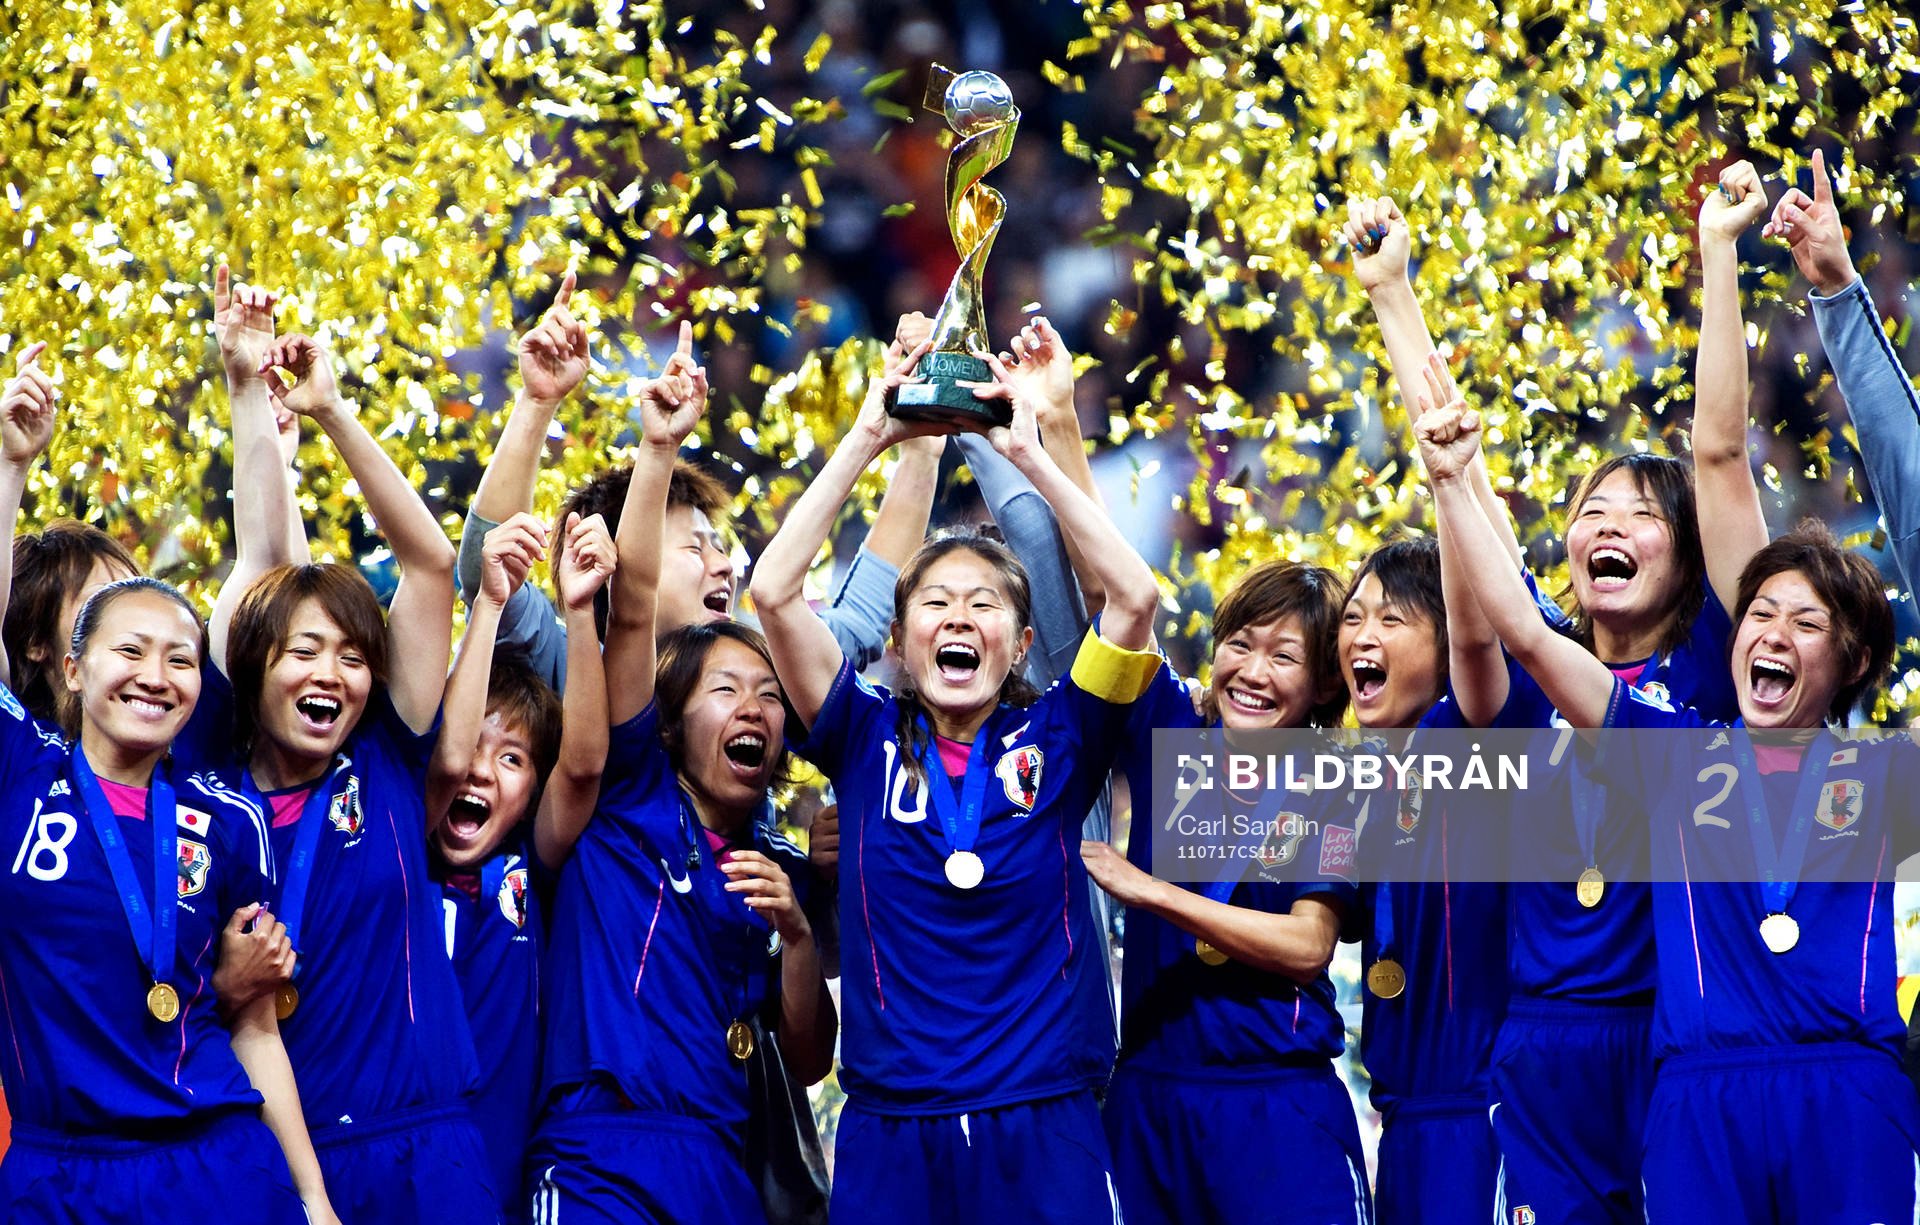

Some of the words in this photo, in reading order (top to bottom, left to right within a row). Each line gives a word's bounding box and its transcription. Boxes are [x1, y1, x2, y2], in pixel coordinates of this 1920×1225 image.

[882, 740, 929, 823] 10
[1165, 758, 1207, 831] 9
[1693, 763, 1739, 829] 2
[12, 797, 78, 881] 18
